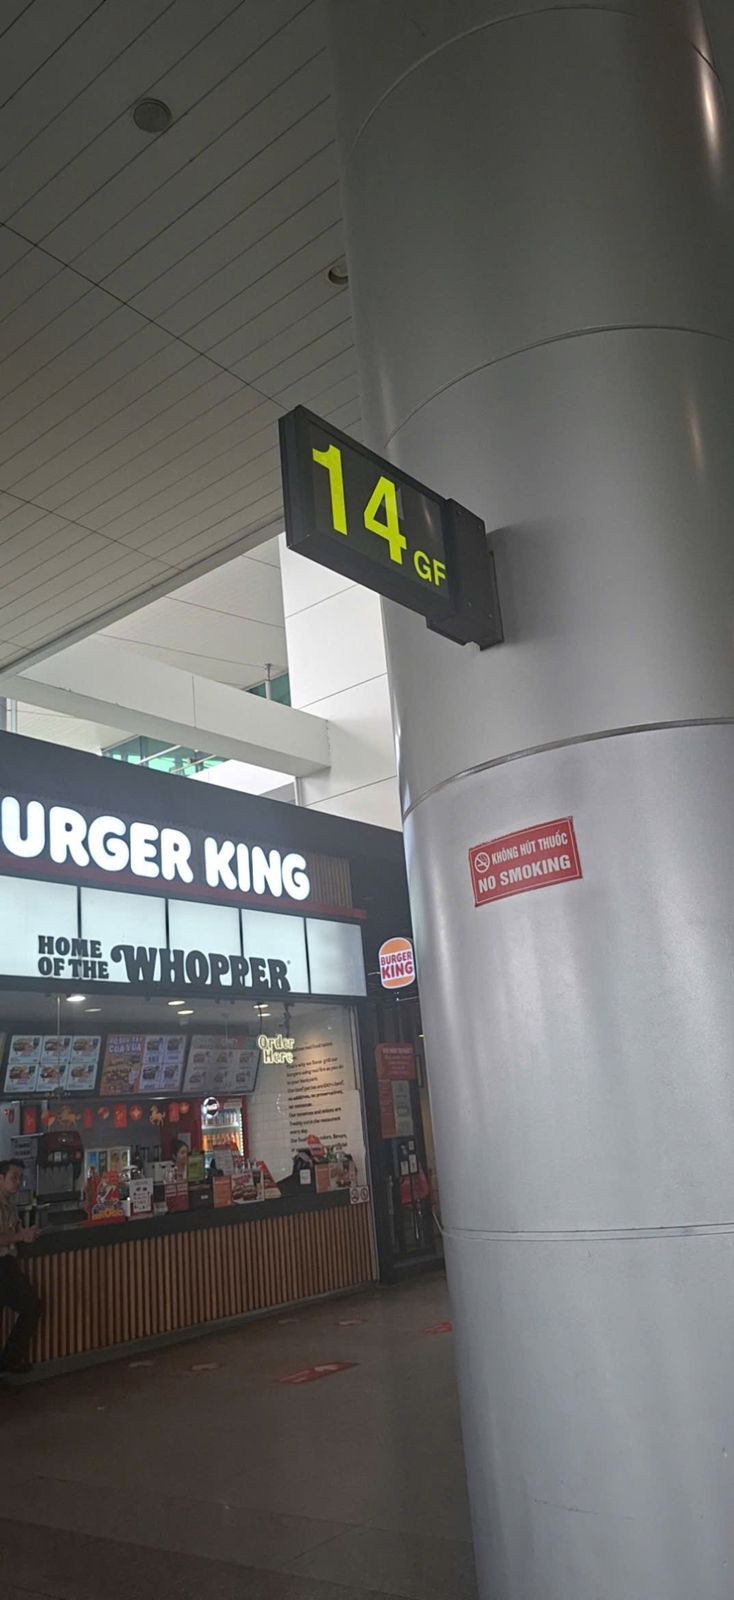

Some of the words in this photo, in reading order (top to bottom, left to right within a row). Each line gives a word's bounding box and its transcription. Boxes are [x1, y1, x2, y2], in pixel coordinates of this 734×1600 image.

[312, 444, 407, 565] 14
[413, 550, 446, 586] GF
[491, 846, 519, 865] KHÔNG
[520, 840, 536, 856] HÚT
[537, 830, 568, 850] THUỐC
[204, 837, 310, 901] KING
[478, 875, 496, 893] NO
[500, 854, 571, 886] SMOKING
[38, 935, 102, 958] HOME
[38, 956, 65, 976] OF
[68, 958, 109, 979] THE
[110, 944, 291, 993] WHOPPER
[380, 951, 412, 966] BURGER
[381, 961, 413, 979] KING
[258, 1034, 295, 1050] Order
[263, 1048, 294, 1064] Here
